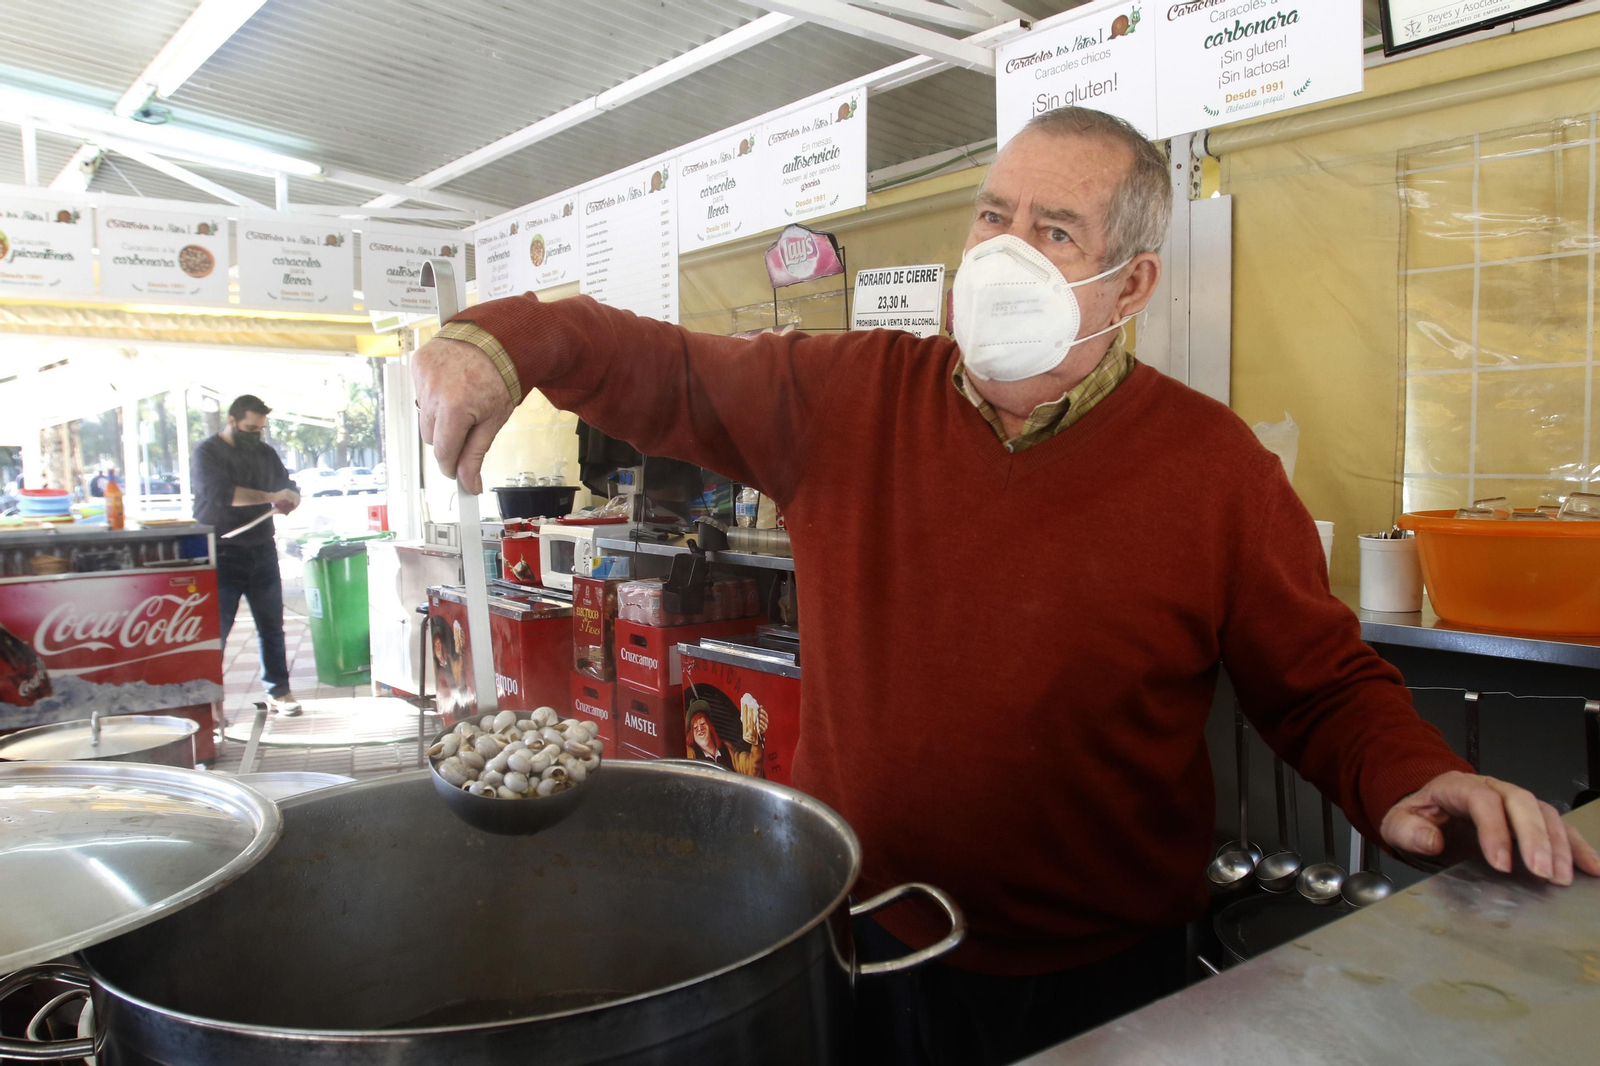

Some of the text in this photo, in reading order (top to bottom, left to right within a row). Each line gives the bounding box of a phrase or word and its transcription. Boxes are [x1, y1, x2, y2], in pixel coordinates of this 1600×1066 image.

[1210, 0, 1266, 23] Caracoles
[1427, 10, 1453, 24] Reyes
[1455, 8, 1460, 19] y
[1428, 16, 1472, 32] ASESORAMIENTO
[1483, 4, 1511, 16] EMPRESAS
[1204, 9, 1300, 50] carbonara
[1005, 28, 1104, 75] Caracoles los Patos I
[1220, 35, 1288, 69] ¡Sin gluten!
[1034, 48, 1112, 80] Caracoles chicos
[1218, 54, 1290, 90] ¡Sin lactosa!
[1032, 72, 1118, 118] ¡Sin gluten!
[1225, 80, 1284, 104] Desde 1991
[768, 128, 800, 146] Caracoles
[802, 137, 832, 153] En mesas
[782, 144, 840, 174] autoservicio
[682, 161, 709, 177] Caracoles
[706, 169, 728, 182] Tenemos
[782, 174, 802, 186] Abonen
[809, 170, 818, 178] ser
[818, 162, 840, 175] servidos
[700, 176, 737, 199] caracoles
[586, 197, 616, 216] Caracoles
[712, 195, 724, 205] para
[795, 194, 826, 208] Desde 1991
[707, 203, 729, 220] llevar
[706, 224, 720, 234] Desde
[112, 253, 176, 268] carbonara
[281, 247, 311, 256] Tenemos
[783, 235, 814, 267] Lay's
[272, 257, 322, 268] caracoles
[386, 266, 421, 277] autoser
[282, 273, 312, 286] llevar
[858, 268, 938, 287] HORARIO DE CIERRE
[878, 295, 909, 312] 23,30 H.
[856, 319, 880, 327] PROHIBIDA
[887, 318, 903, 326] VENTA
[904, 318, 911, 326] DE
[34, 592, 210, 656] Coca-Cola
[620, 647, 658, 670] Cruzcampo
[575, 698, 608, 720] Cruzcampo
[624, 712, 658, 737] AMSTEL
